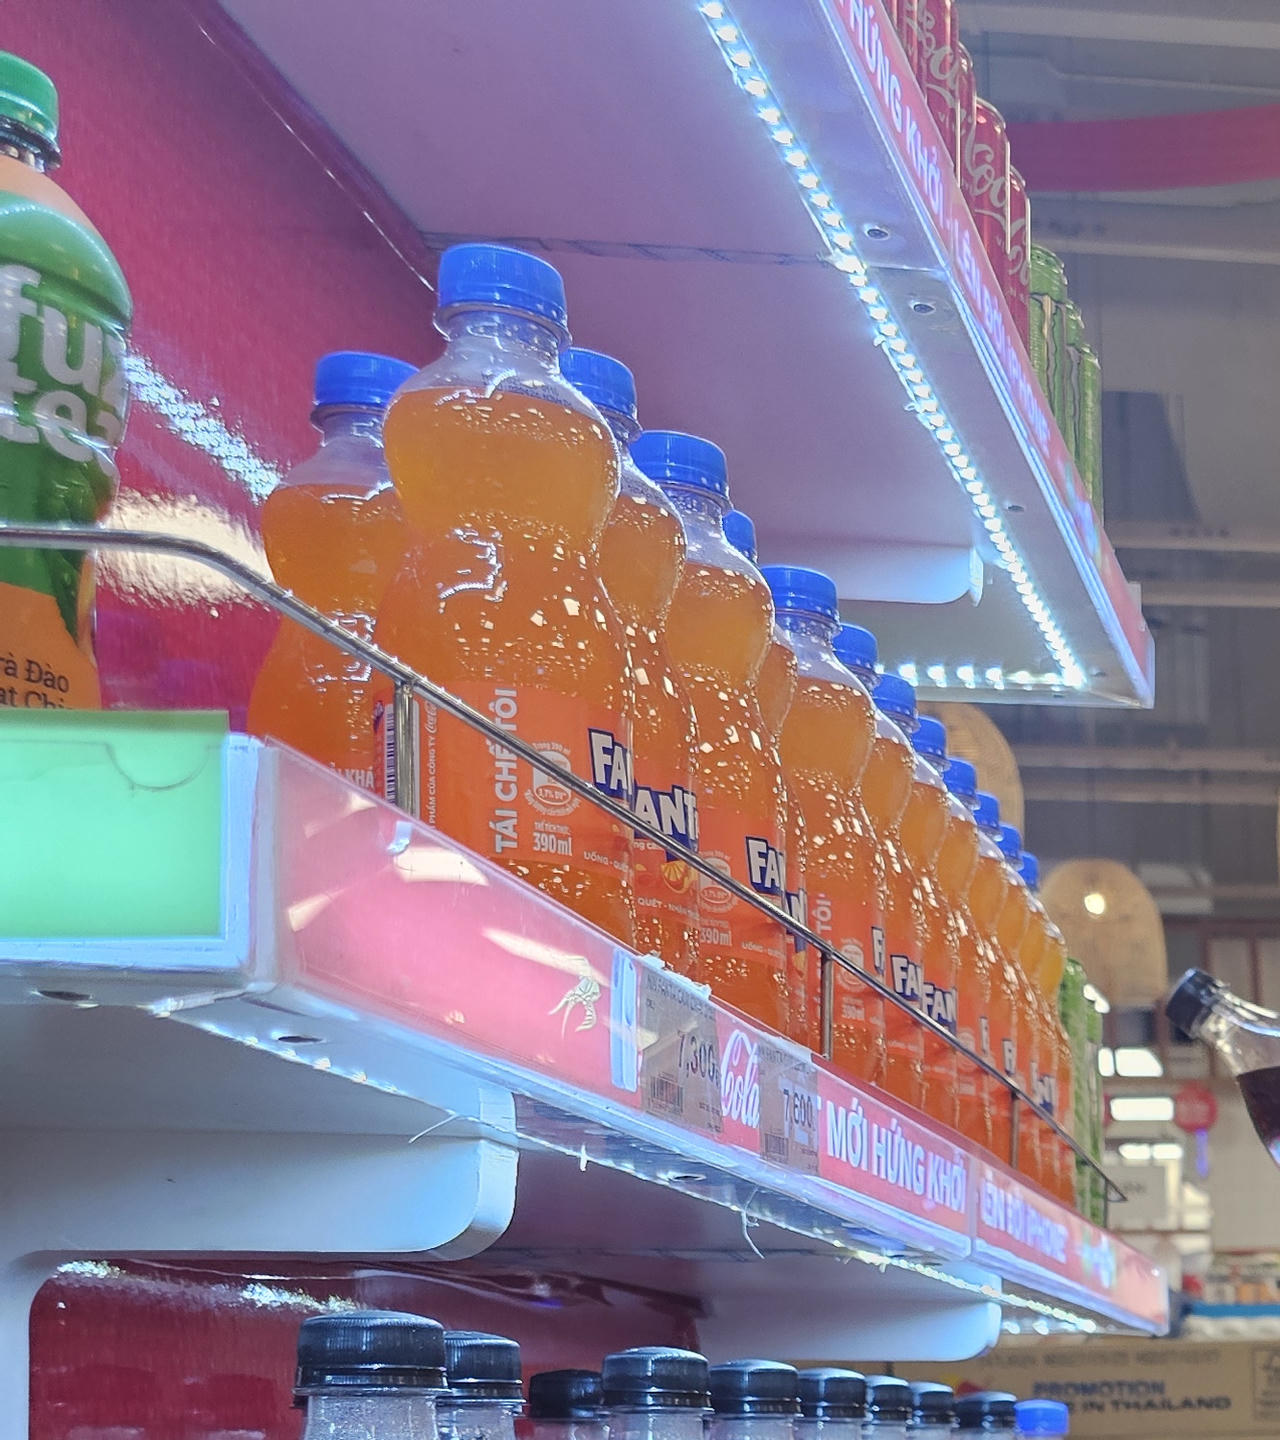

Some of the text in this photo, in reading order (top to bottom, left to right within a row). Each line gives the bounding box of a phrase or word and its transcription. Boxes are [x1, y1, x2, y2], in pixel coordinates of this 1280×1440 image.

[24, 659, 69, 693] Đào
[489, 810, 518, 853] TÁI
[635, 787, 698, 842] ANT
[827, 1098, 967, 1214] MỚI HỨNG KHỞI
[1112, 1396, 1232, 1412] THAILAND
